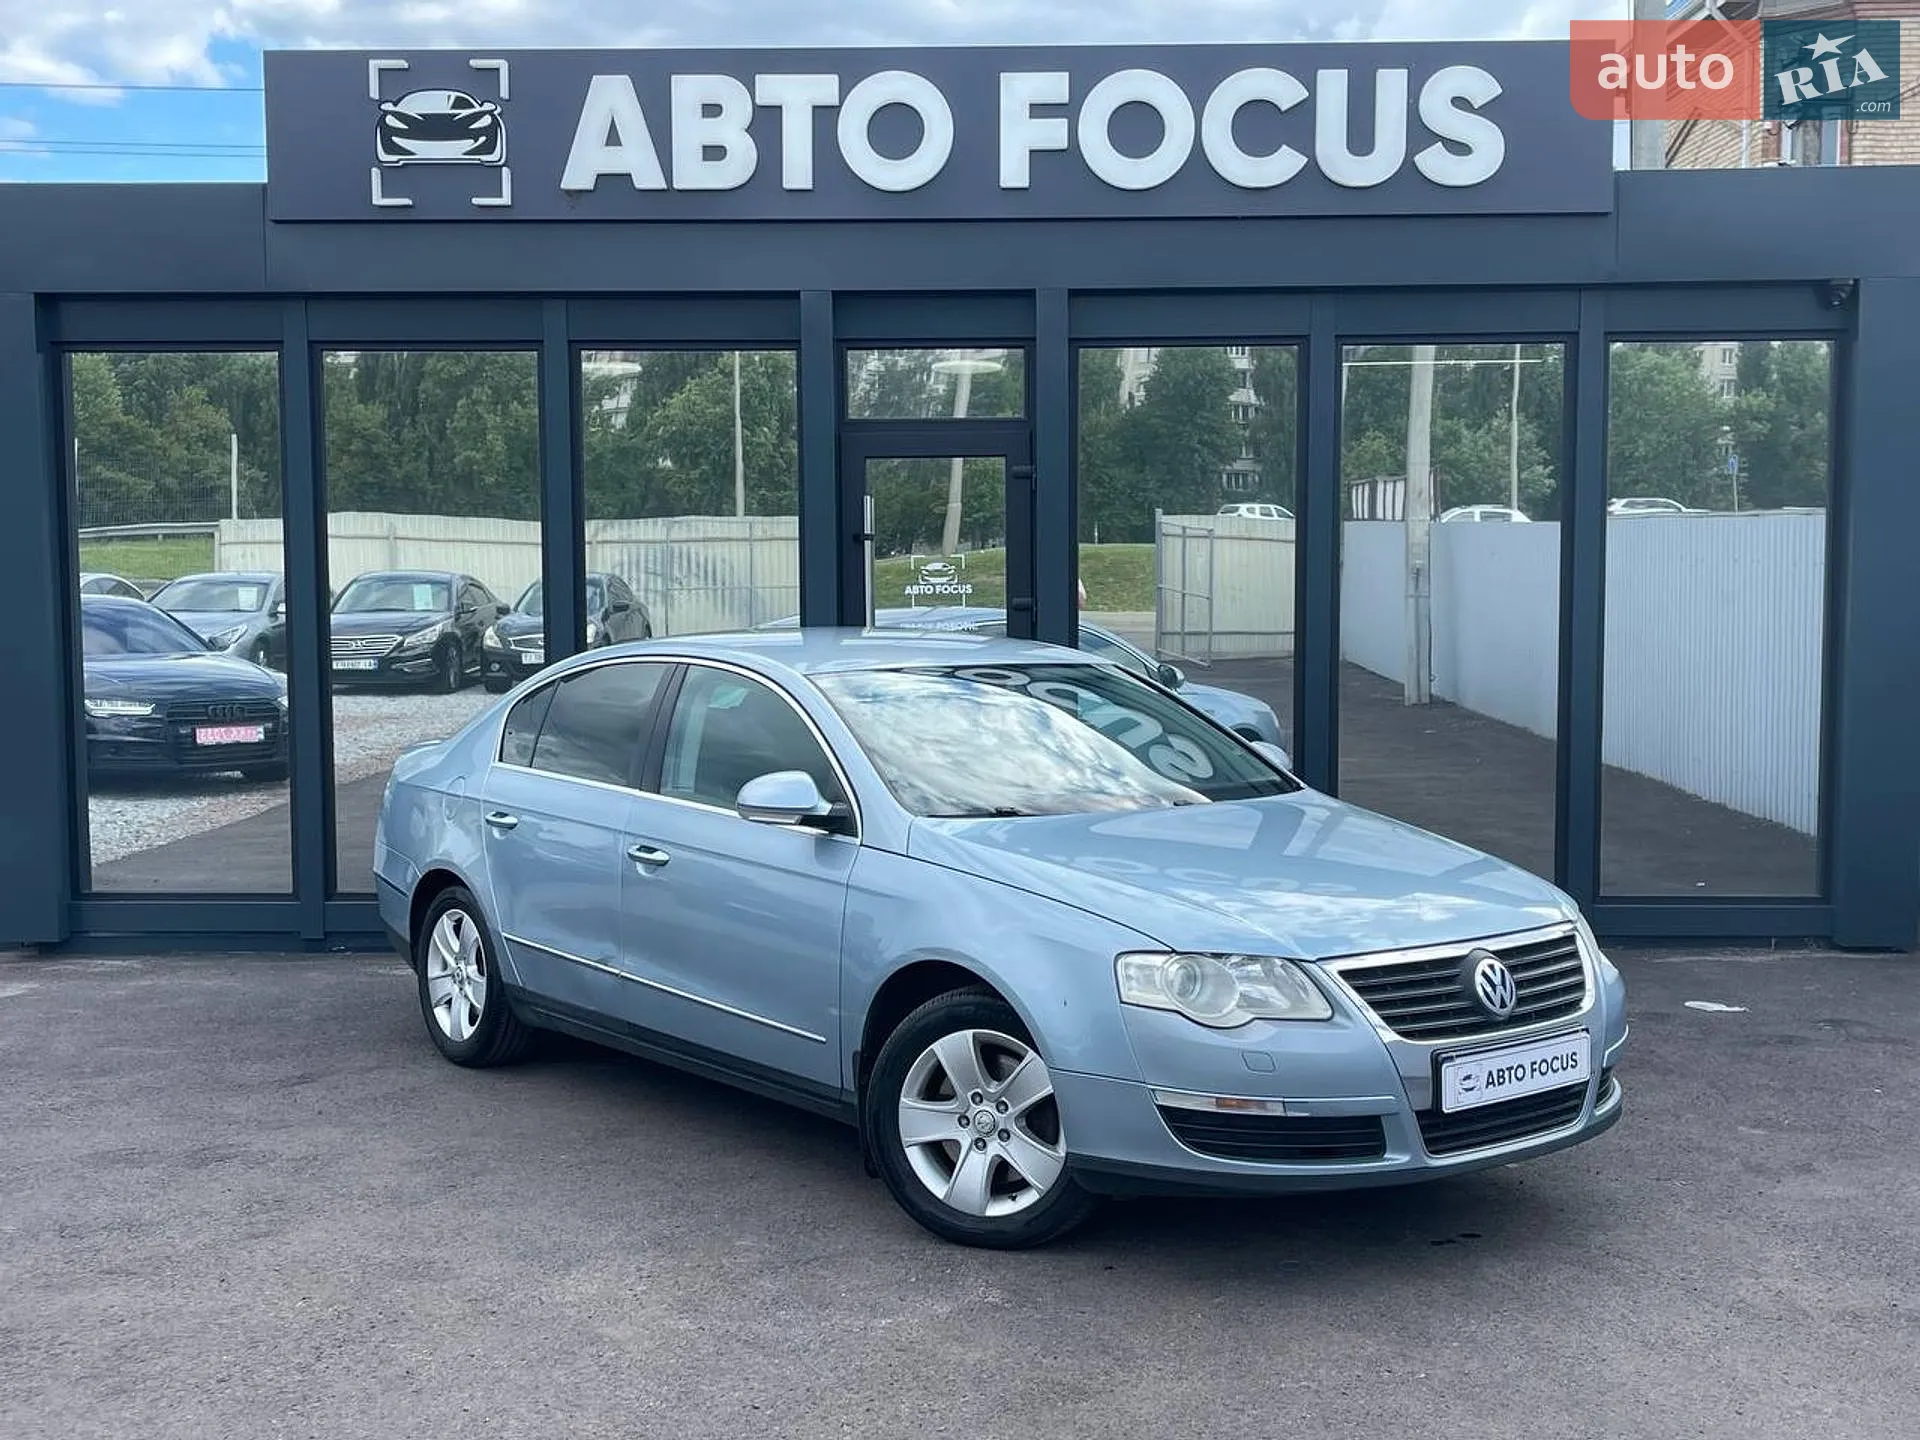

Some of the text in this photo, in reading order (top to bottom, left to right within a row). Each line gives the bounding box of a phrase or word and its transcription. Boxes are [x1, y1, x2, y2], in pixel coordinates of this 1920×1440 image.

[560, 65, 1506, 192] АВТО FOCUS
[936, 584, 973, 594] FOCUS
[1475, 960, 1515, 1014] VW
[1486, 1053, 1577, 1089] АВТО FOCUS
